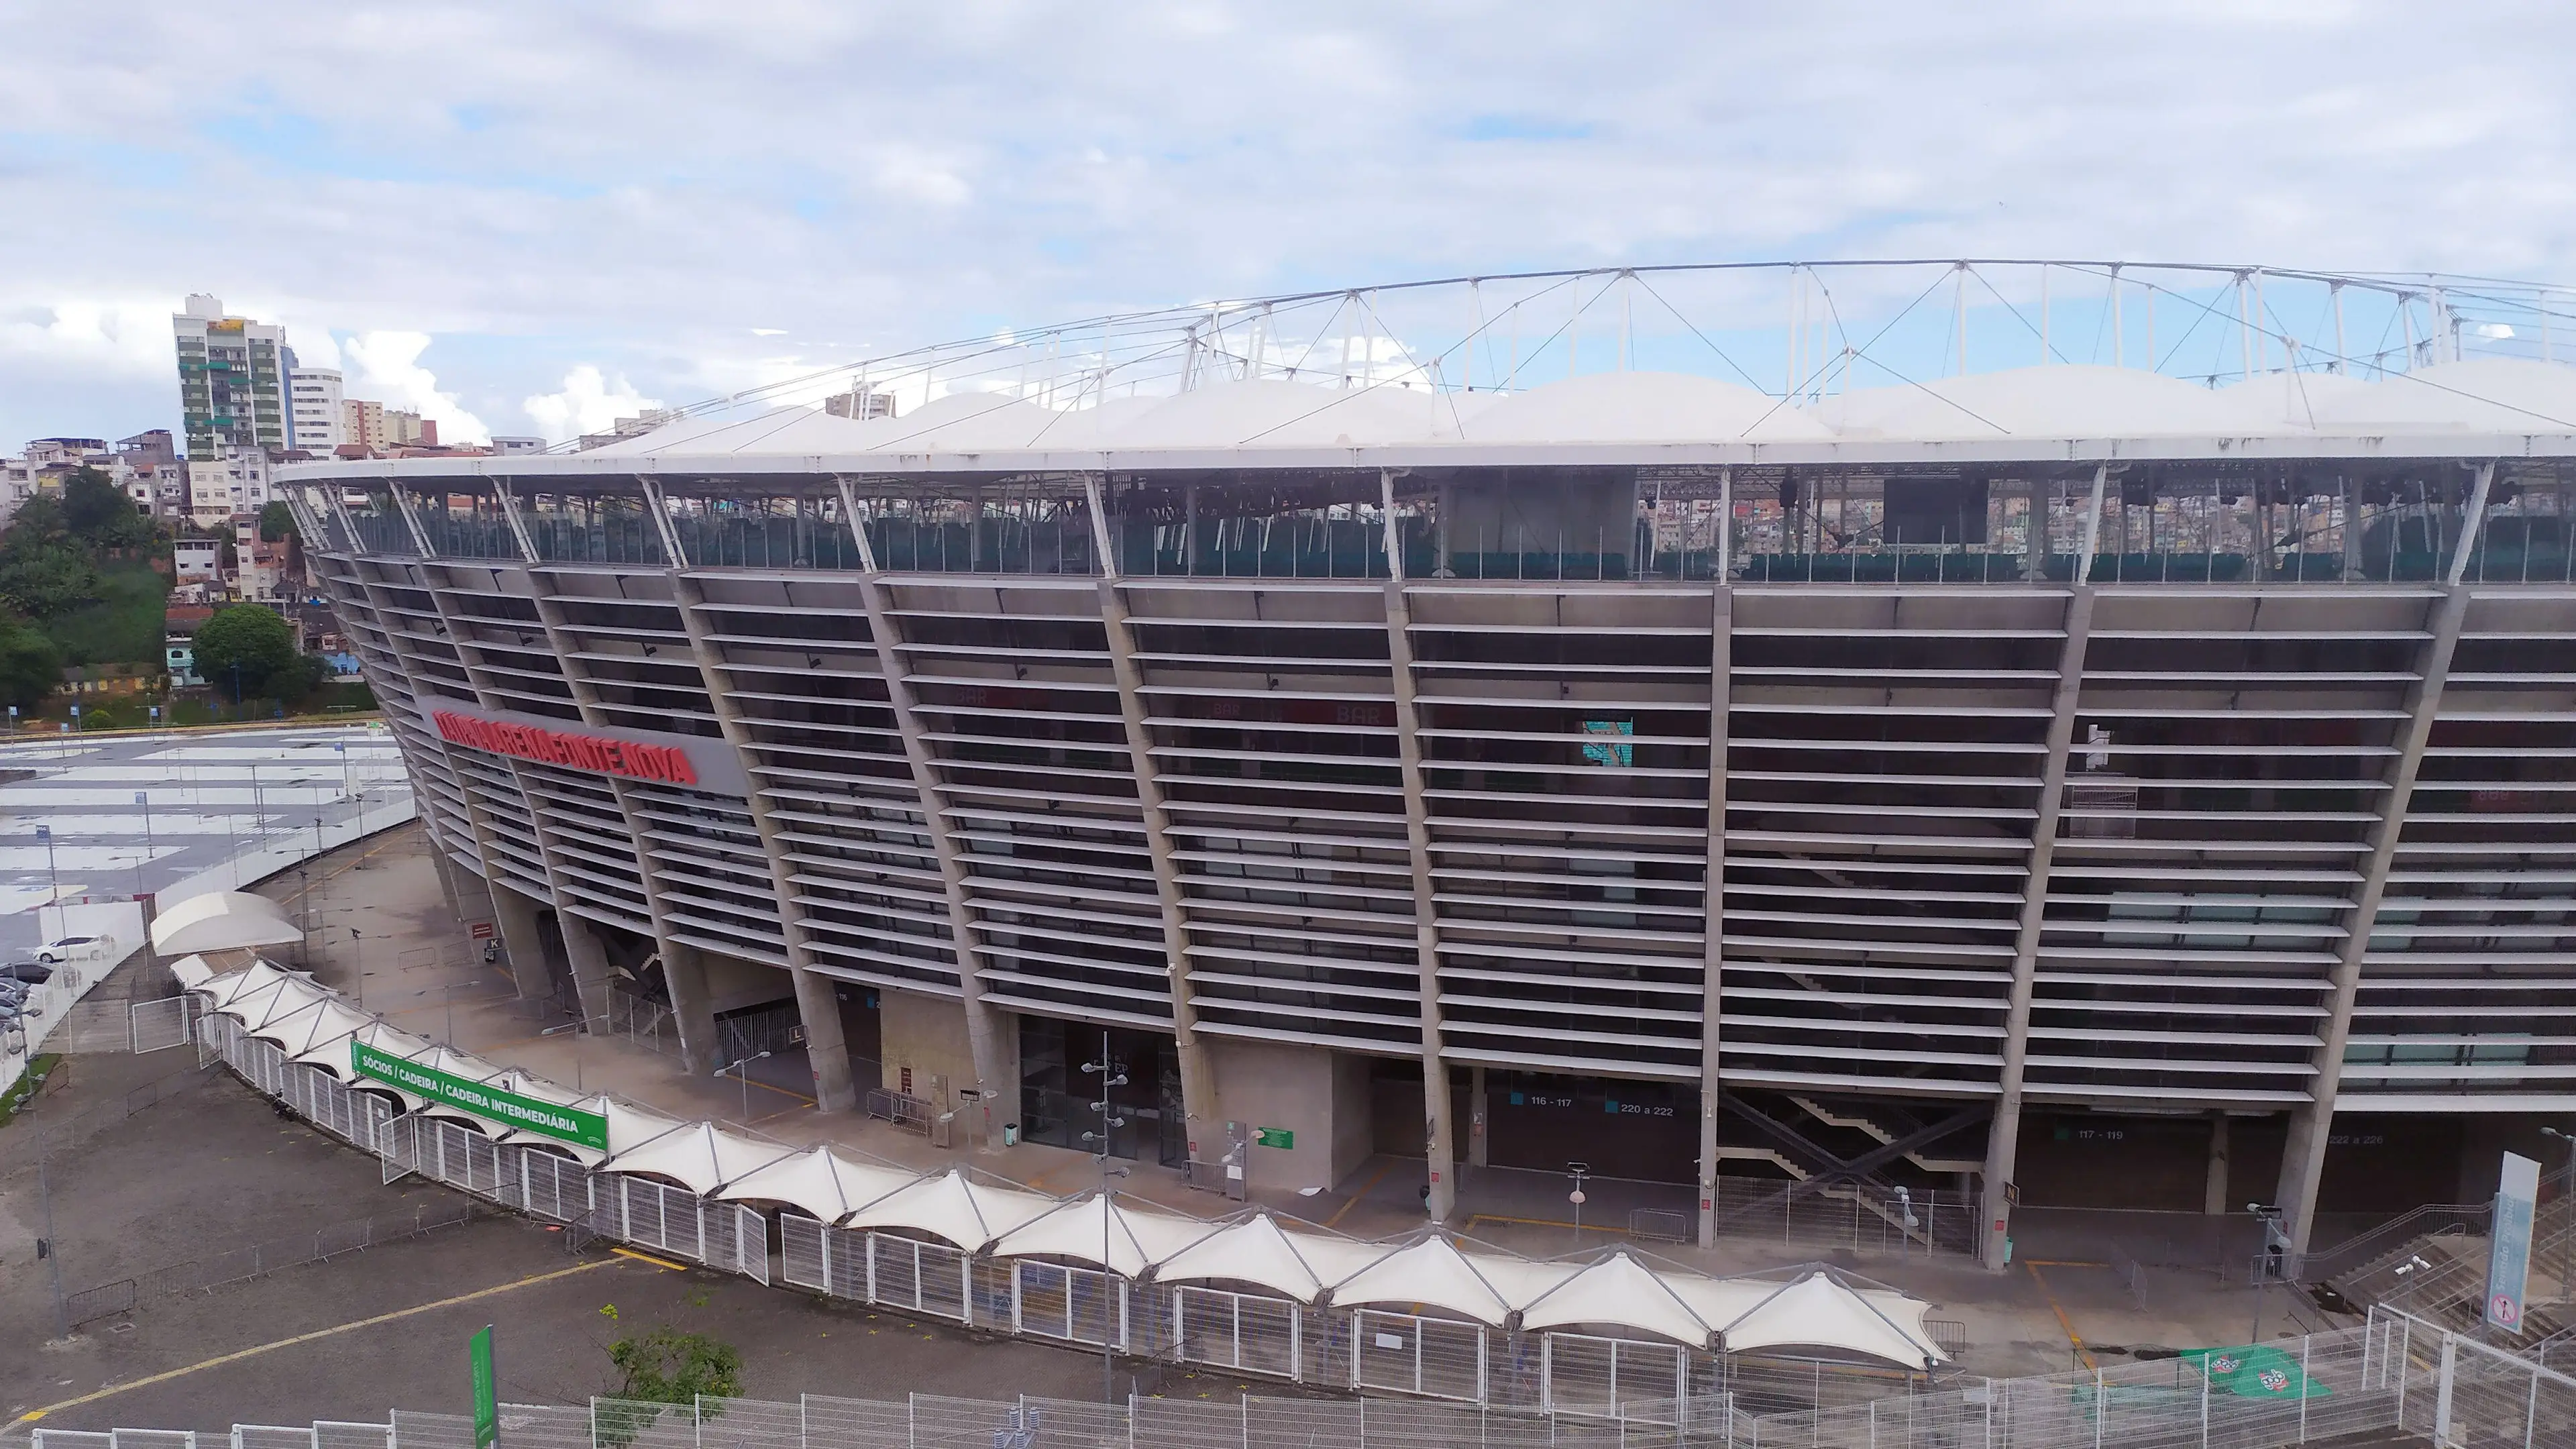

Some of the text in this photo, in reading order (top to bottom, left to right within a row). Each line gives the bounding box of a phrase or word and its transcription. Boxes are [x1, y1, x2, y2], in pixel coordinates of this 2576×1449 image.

[1214, 704, 1240, 716] BAR
[1338, 705, 1380, 724] BAR
[490, 721, 558, 763] ARENA
[547, 733, 628, 775] FONTE
[619, 741, 698, 785] NOVA
[491, 939, 498, 948] K
[363, 1055, 393, 1076] SÓCIOS
[394, 1065, 398, 1079] /
[399, 1069, 439, 1093] CADEIRA
[440, 1081, 445, 1095] /
[445, 1084, 489, 1109] CADEIRA
[492, 1098, 579, 1134] INTERMEDIÁRIA
[1531, 1096, 1547, 1106] 116
[1556, 1097, 1572, 1107] 117
[1621, 1104, 1641, 1114] 220
[1653, 1107, 1674, 1117] 222
[2079, 1130, 2095, 1139] 117
[2106, 1130, 2123, 1140] 119
[2328, 1135, 2349, 1144] 222
[2501, 1195, 2515, 1243] Proibid
